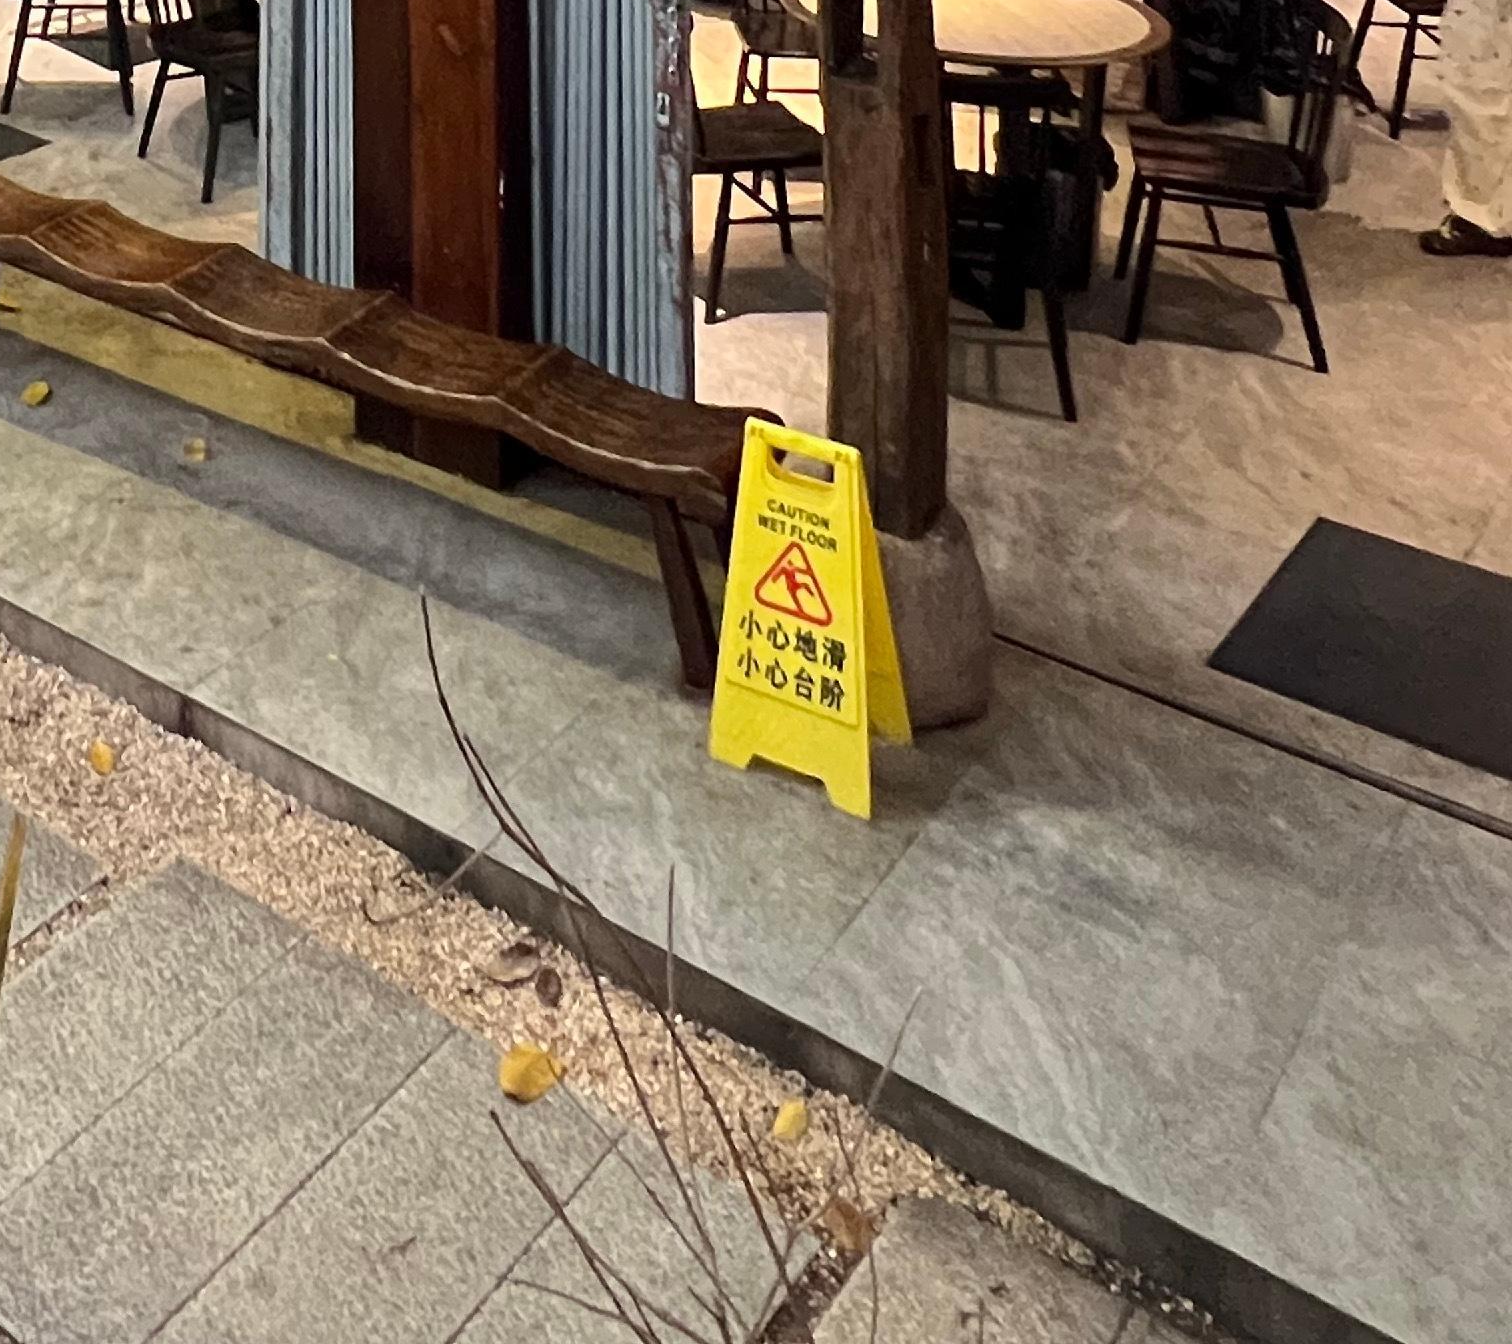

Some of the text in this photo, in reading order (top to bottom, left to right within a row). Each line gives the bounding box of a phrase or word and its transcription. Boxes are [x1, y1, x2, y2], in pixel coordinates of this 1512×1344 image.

[757, 513, 838, 553] WET FLOOR
[766, 498, 830, 530] CAUTION
[738, 609, 848, 674] 小心地滑
[736, 647, 846, 713] 小心台阶
